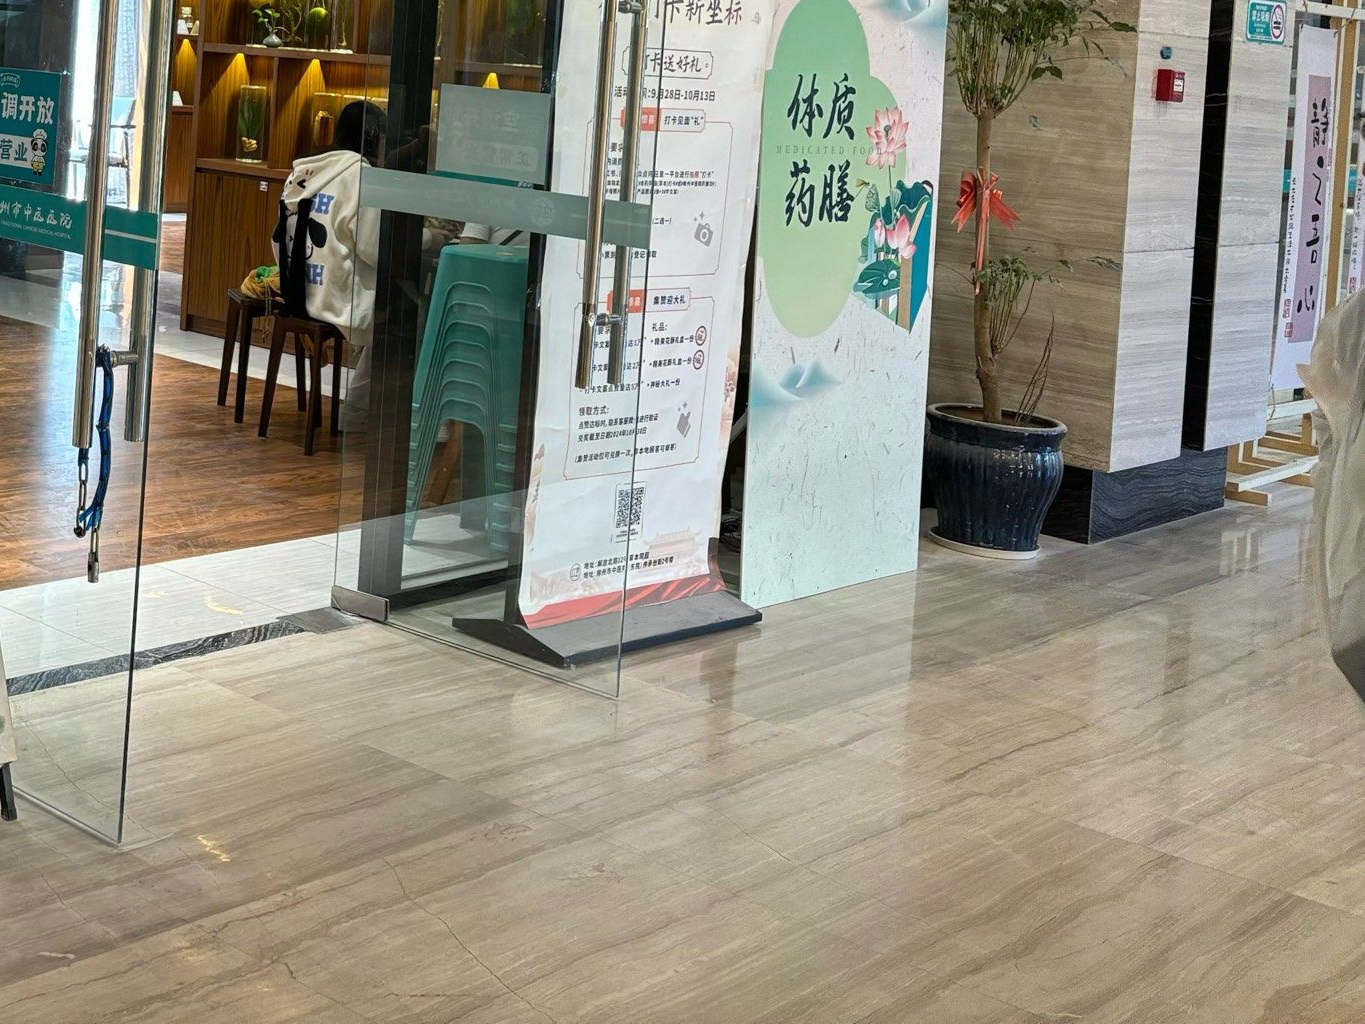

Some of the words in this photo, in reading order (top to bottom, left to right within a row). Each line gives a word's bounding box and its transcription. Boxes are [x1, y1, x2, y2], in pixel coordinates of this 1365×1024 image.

[787, 72, 857, 141] 体质
[776, 144, 845, 155] MEDICATED
[785, 159, 855, 229] 药膳
